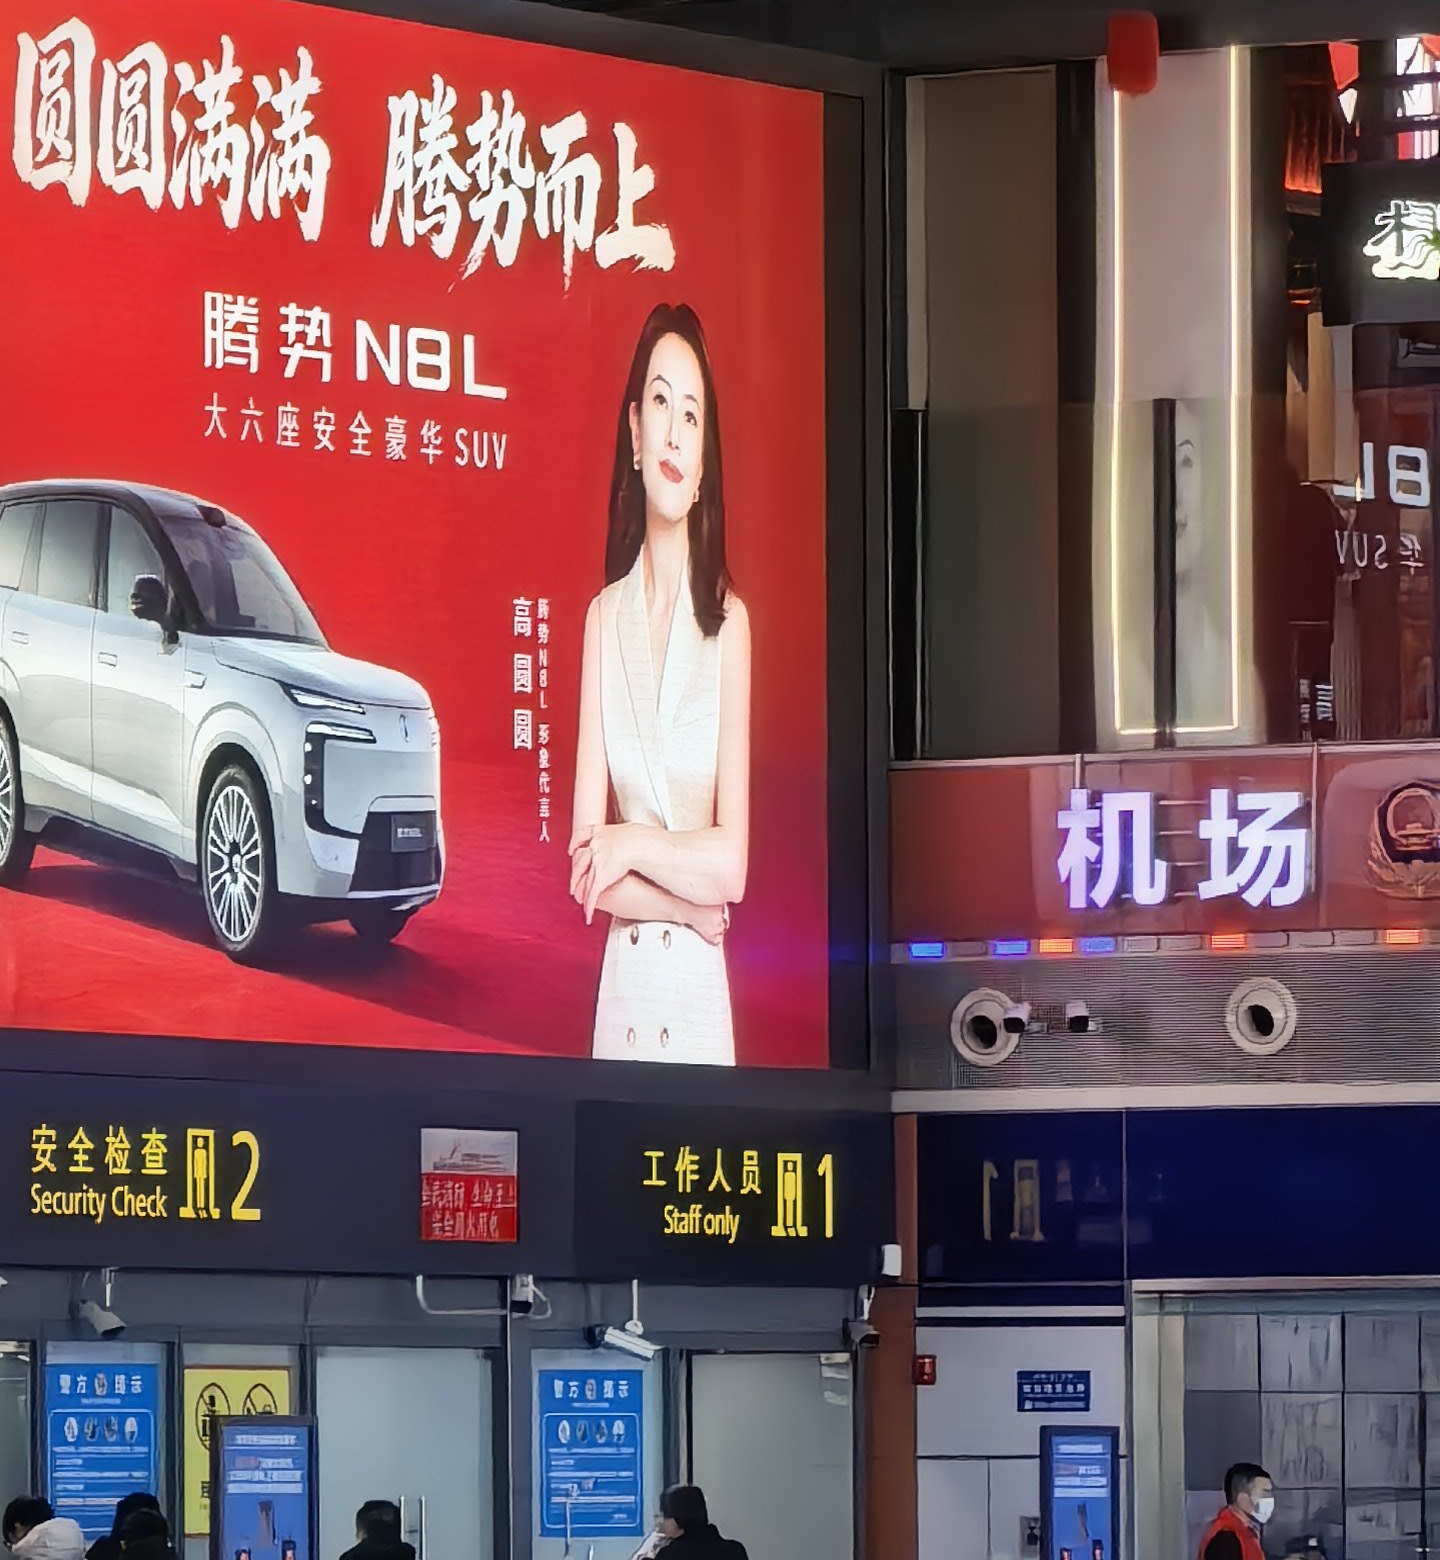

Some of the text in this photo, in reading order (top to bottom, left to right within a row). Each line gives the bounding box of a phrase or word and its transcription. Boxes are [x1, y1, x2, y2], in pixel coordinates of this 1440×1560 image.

[13, 15, 677, 291] 圆圆满满 腾势而上
[203, 290, 507, 399] 腾势 N8L
[203, 393, 508, 471] 大六座安全豪华SUV
[513, 597, 533, 749] 高圆圆
[1057, 788, 1308, 909] 机场
[31, 1124, 167, 1175] 安全检查
[231, 1131, 260, 1220] 2
[643, 1146, 761, 1194] 工作人员
[31, 1183, 167, 1224] Security Check
[662, 1204, 740, 1243] Staff only
[817, 1154, 833, 1238] 1
